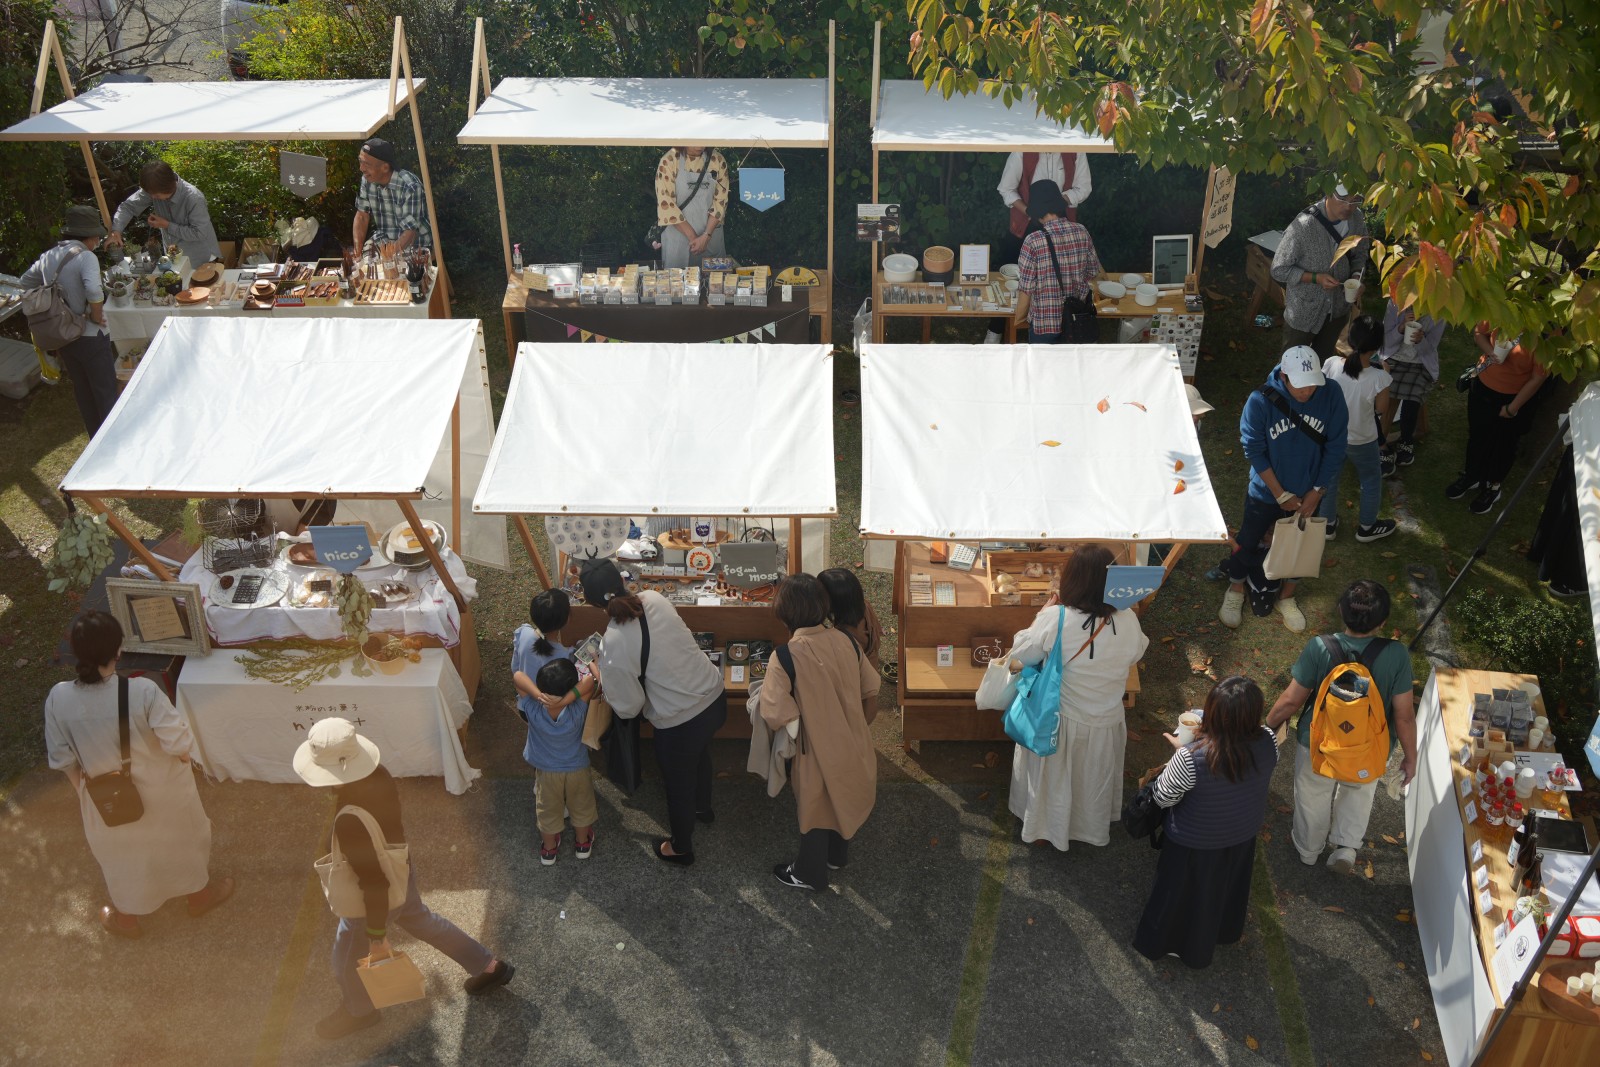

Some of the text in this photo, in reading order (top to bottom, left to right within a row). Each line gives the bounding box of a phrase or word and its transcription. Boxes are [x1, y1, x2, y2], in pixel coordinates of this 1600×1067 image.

[288, 174, 316, 187] きまま
[743, 190, 781, 201] ラ・メール
[1301, 360, 1313, 372] NY
[722, 564, 744, 577] fog
[748, 572, 779, 582] moss
